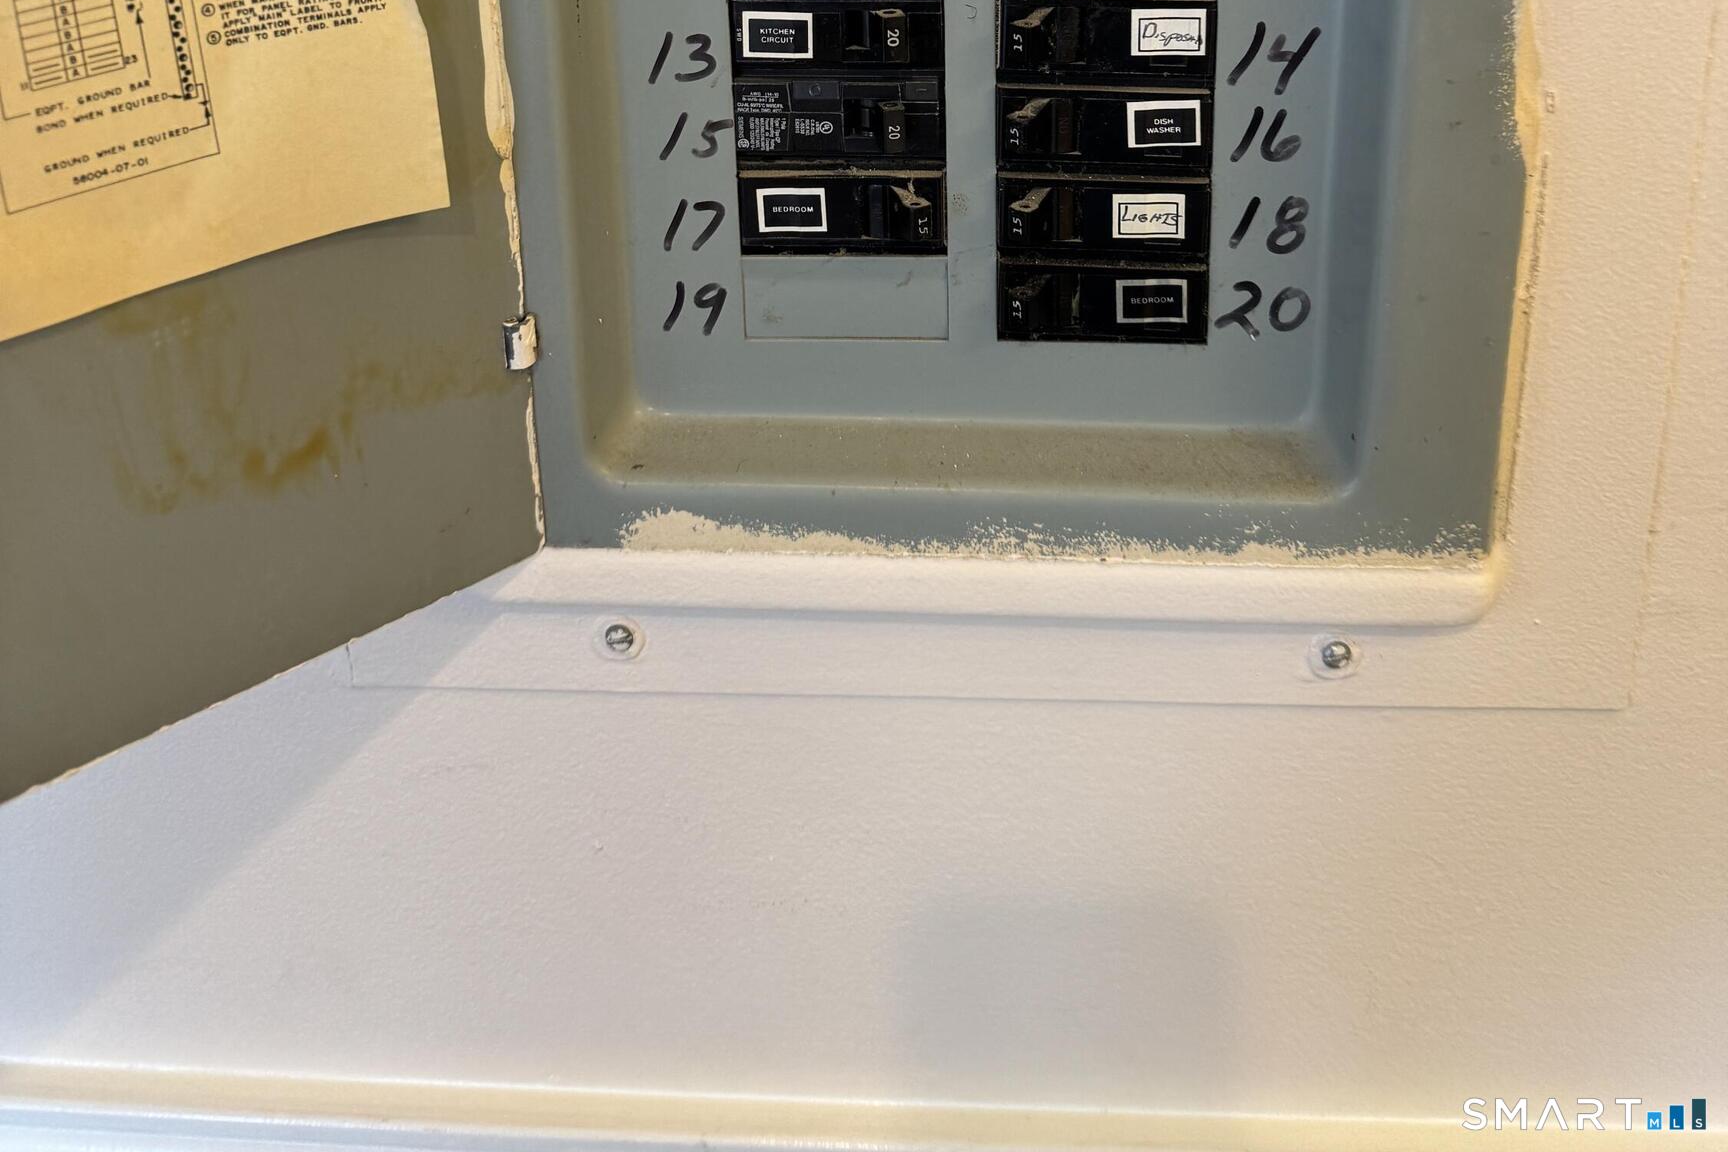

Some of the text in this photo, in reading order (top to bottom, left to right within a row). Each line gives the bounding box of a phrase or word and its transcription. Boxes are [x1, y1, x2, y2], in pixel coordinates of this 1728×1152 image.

[219, 0, 245, 11] WHEN
[221, 11, 229, 19] IT
[262, 2, 292, 13] PANEL
[223, 17, 250, 29] APPLY
[290, 5, 321, 16] LABEL
[330, 2, 342, 10] TO
[224, 3, 387, 37] COMBINATION TERMINALS APPLY
[226, 32, 269, 46] ONLY TO
[759, 28, 795, 36] KITCHEN
[761, 36, 794, 44] CIRCUIT
[887, 29, 900, 47] 20
[1013, 34, 1023, 52] 15
[648, 31, 717, 85] 13
[1226, 21, 1322, 96] 14
[77, 80, 150, 105] GROUND BAR
[73, 92, 169, 124] WHEN REQUIRED
[659, 112, 734, 161] 15
[888, 125, 900, 140] 20
[1010, 128, 1019, 146] 15
[1146, 126, 1181, 134] WASHER
[1229, 106, 1302, 162] 16
[43, 127, 190, 174] GROUND WHEN REQUIRED
[663, 198, 725, 251] 17
[918, 217, 928, 235] 15
[1013, 217, 1023, 236] 15
[1229, 196, 1310, 255] 18
[663, 281, 727, 337] 19
[1012, 300, 1022, 319] 15
[1130, 296, 1175, 305] BEDROOM
[1214, 280, 1311, 343] 20
